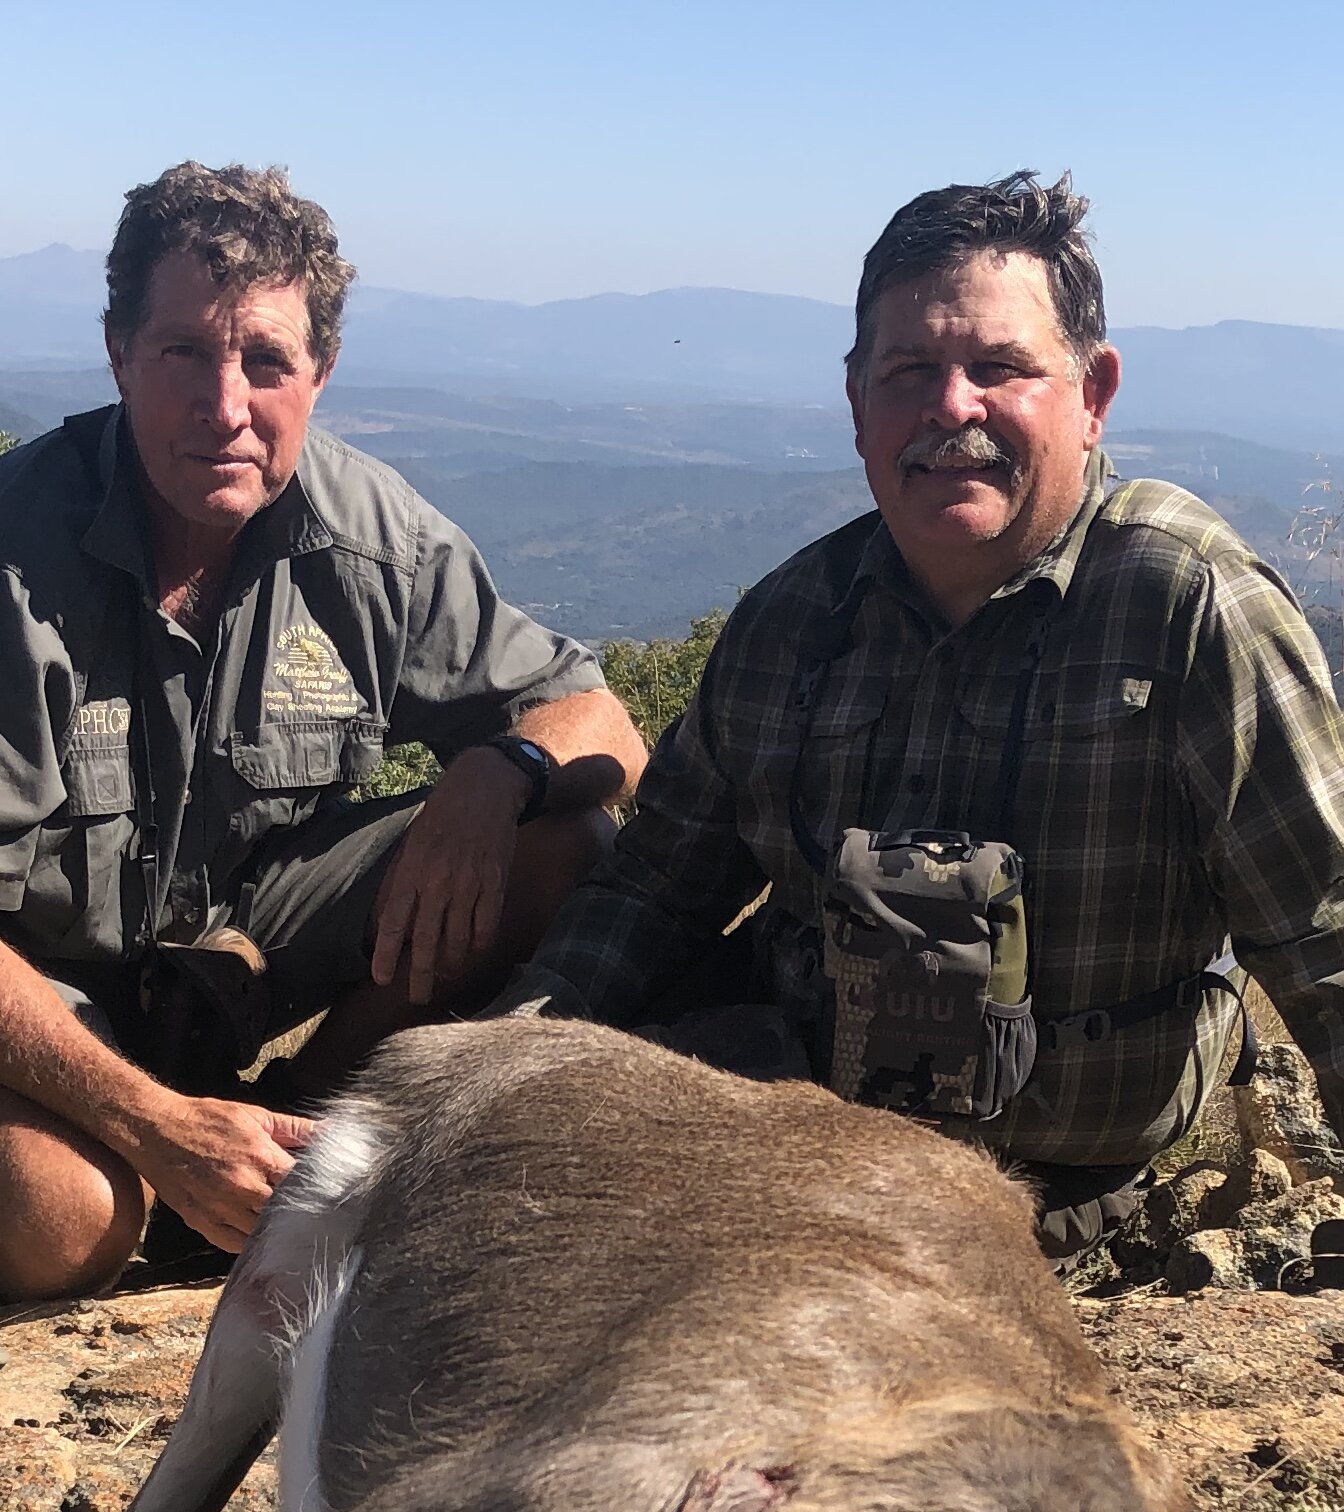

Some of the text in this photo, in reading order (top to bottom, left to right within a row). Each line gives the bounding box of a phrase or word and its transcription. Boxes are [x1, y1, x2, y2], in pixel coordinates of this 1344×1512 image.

[276, 624, 306, 651] SOUTH
[73, 708, 120, 735] PHC
[266, 702, 357, 714] Clay Shooting Academy
